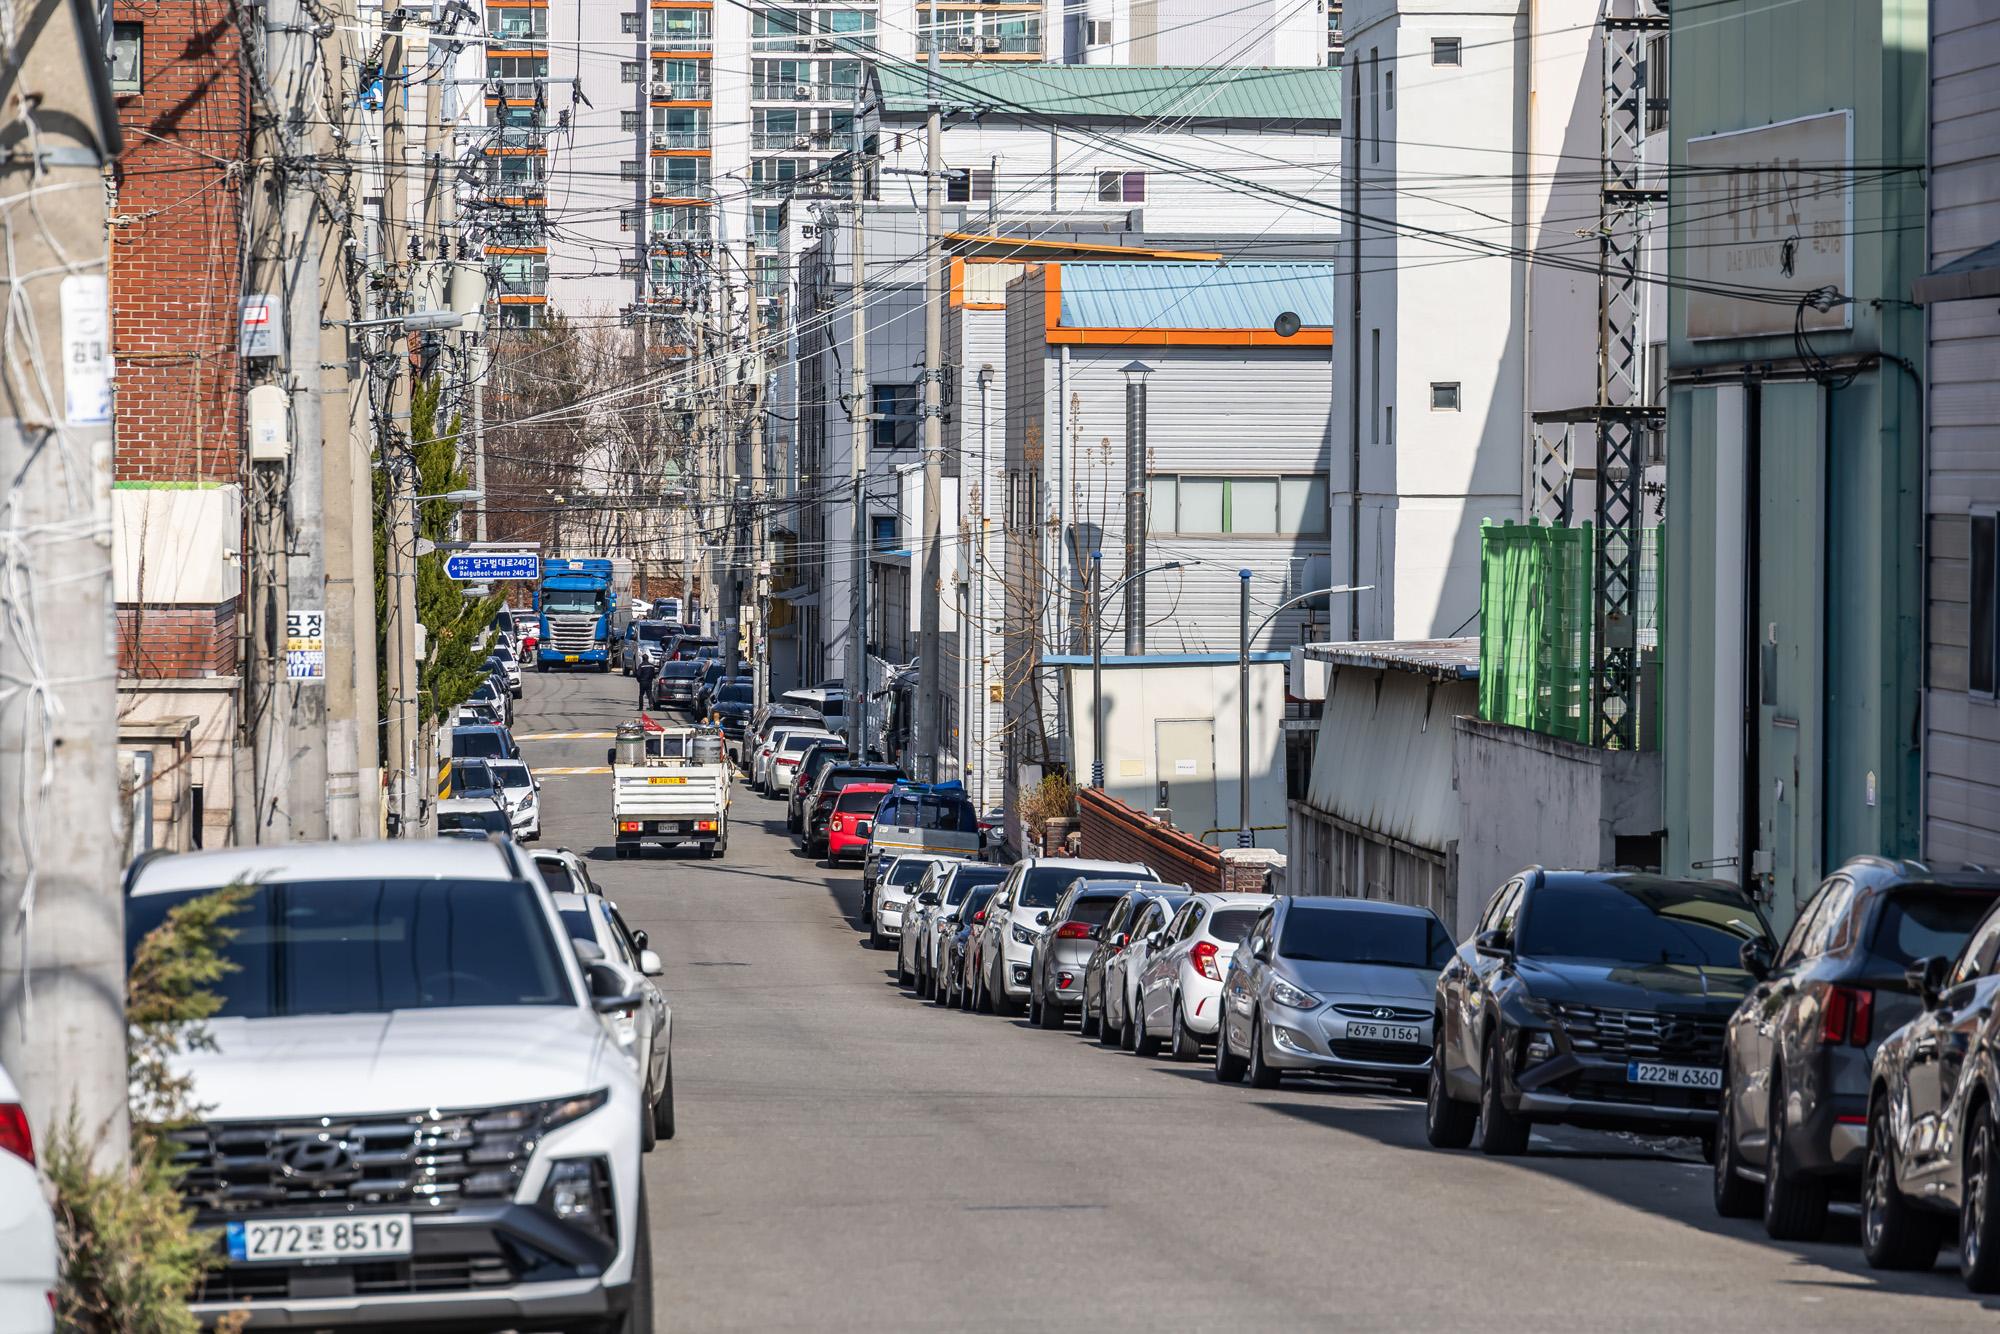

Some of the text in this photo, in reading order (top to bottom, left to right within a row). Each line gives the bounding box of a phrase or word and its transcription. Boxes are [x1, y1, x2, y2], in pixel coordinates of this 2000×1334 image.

[1727, 250, 1742, 271] DAE
[1746, 245, 1774, 269] MYUNG
[473, 558, 535, 569] 달구벌대로240길
[287, 614, 322, 637] 공장
[286, 664, 311, 676] 1177
[1354, 1025, 1413, 1040] 67우 0156
[1640, 1066, 1718, 1085] 222버 6360
[333, 1221, 403, 1250] 8519
